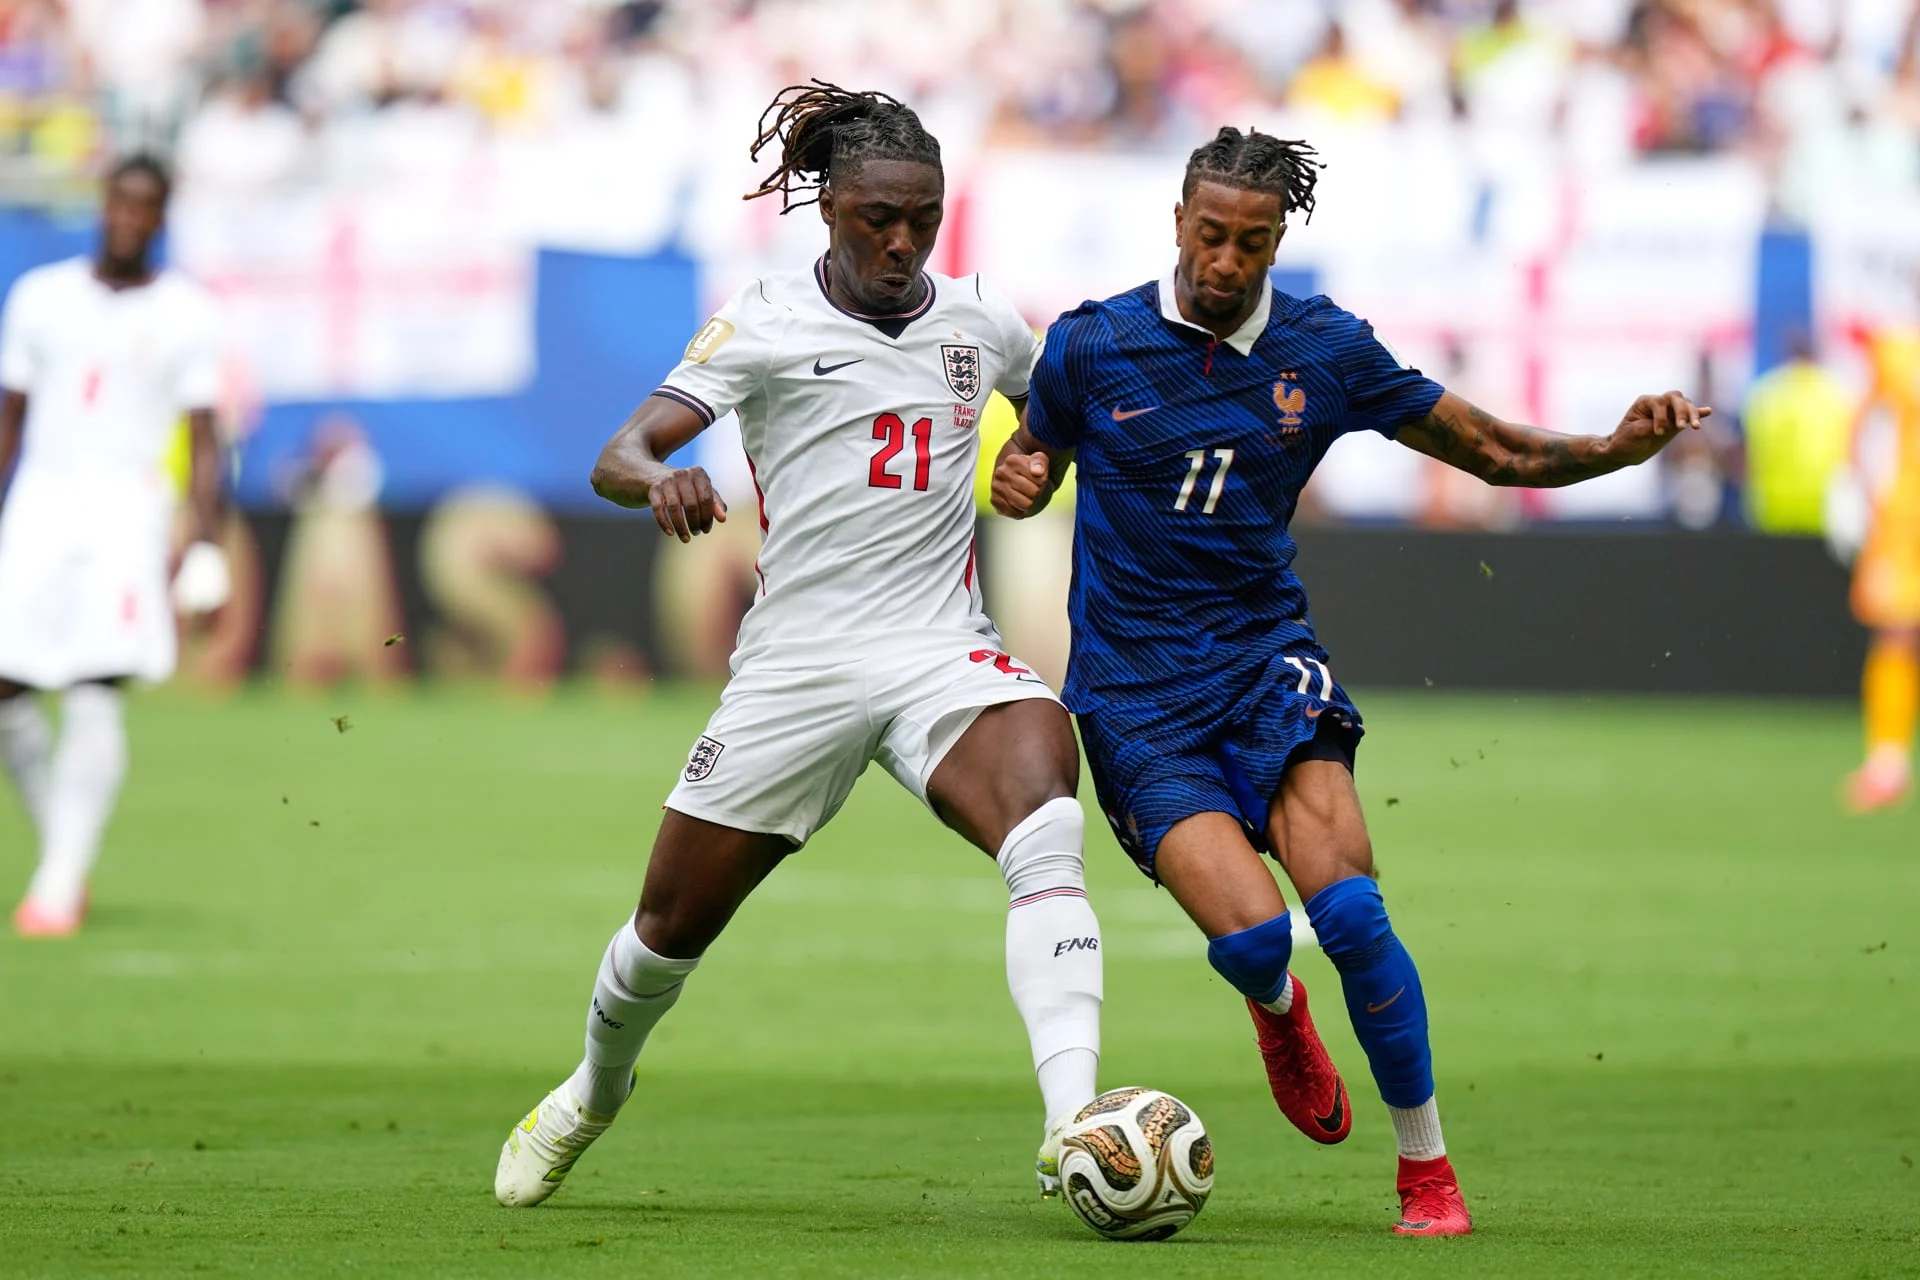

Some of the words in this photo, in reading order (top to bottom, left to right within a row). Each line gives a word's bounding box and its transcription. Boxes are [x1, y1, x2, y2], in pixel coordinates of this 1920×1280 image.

[954, 404, 976, 418] FRANCE
[868, 412, 932, 491] 21
[1174, 448, 1235, 514] 11
[1283, 656, 1332, 702] 11
[1053, 936, 1099, 958] ENG
